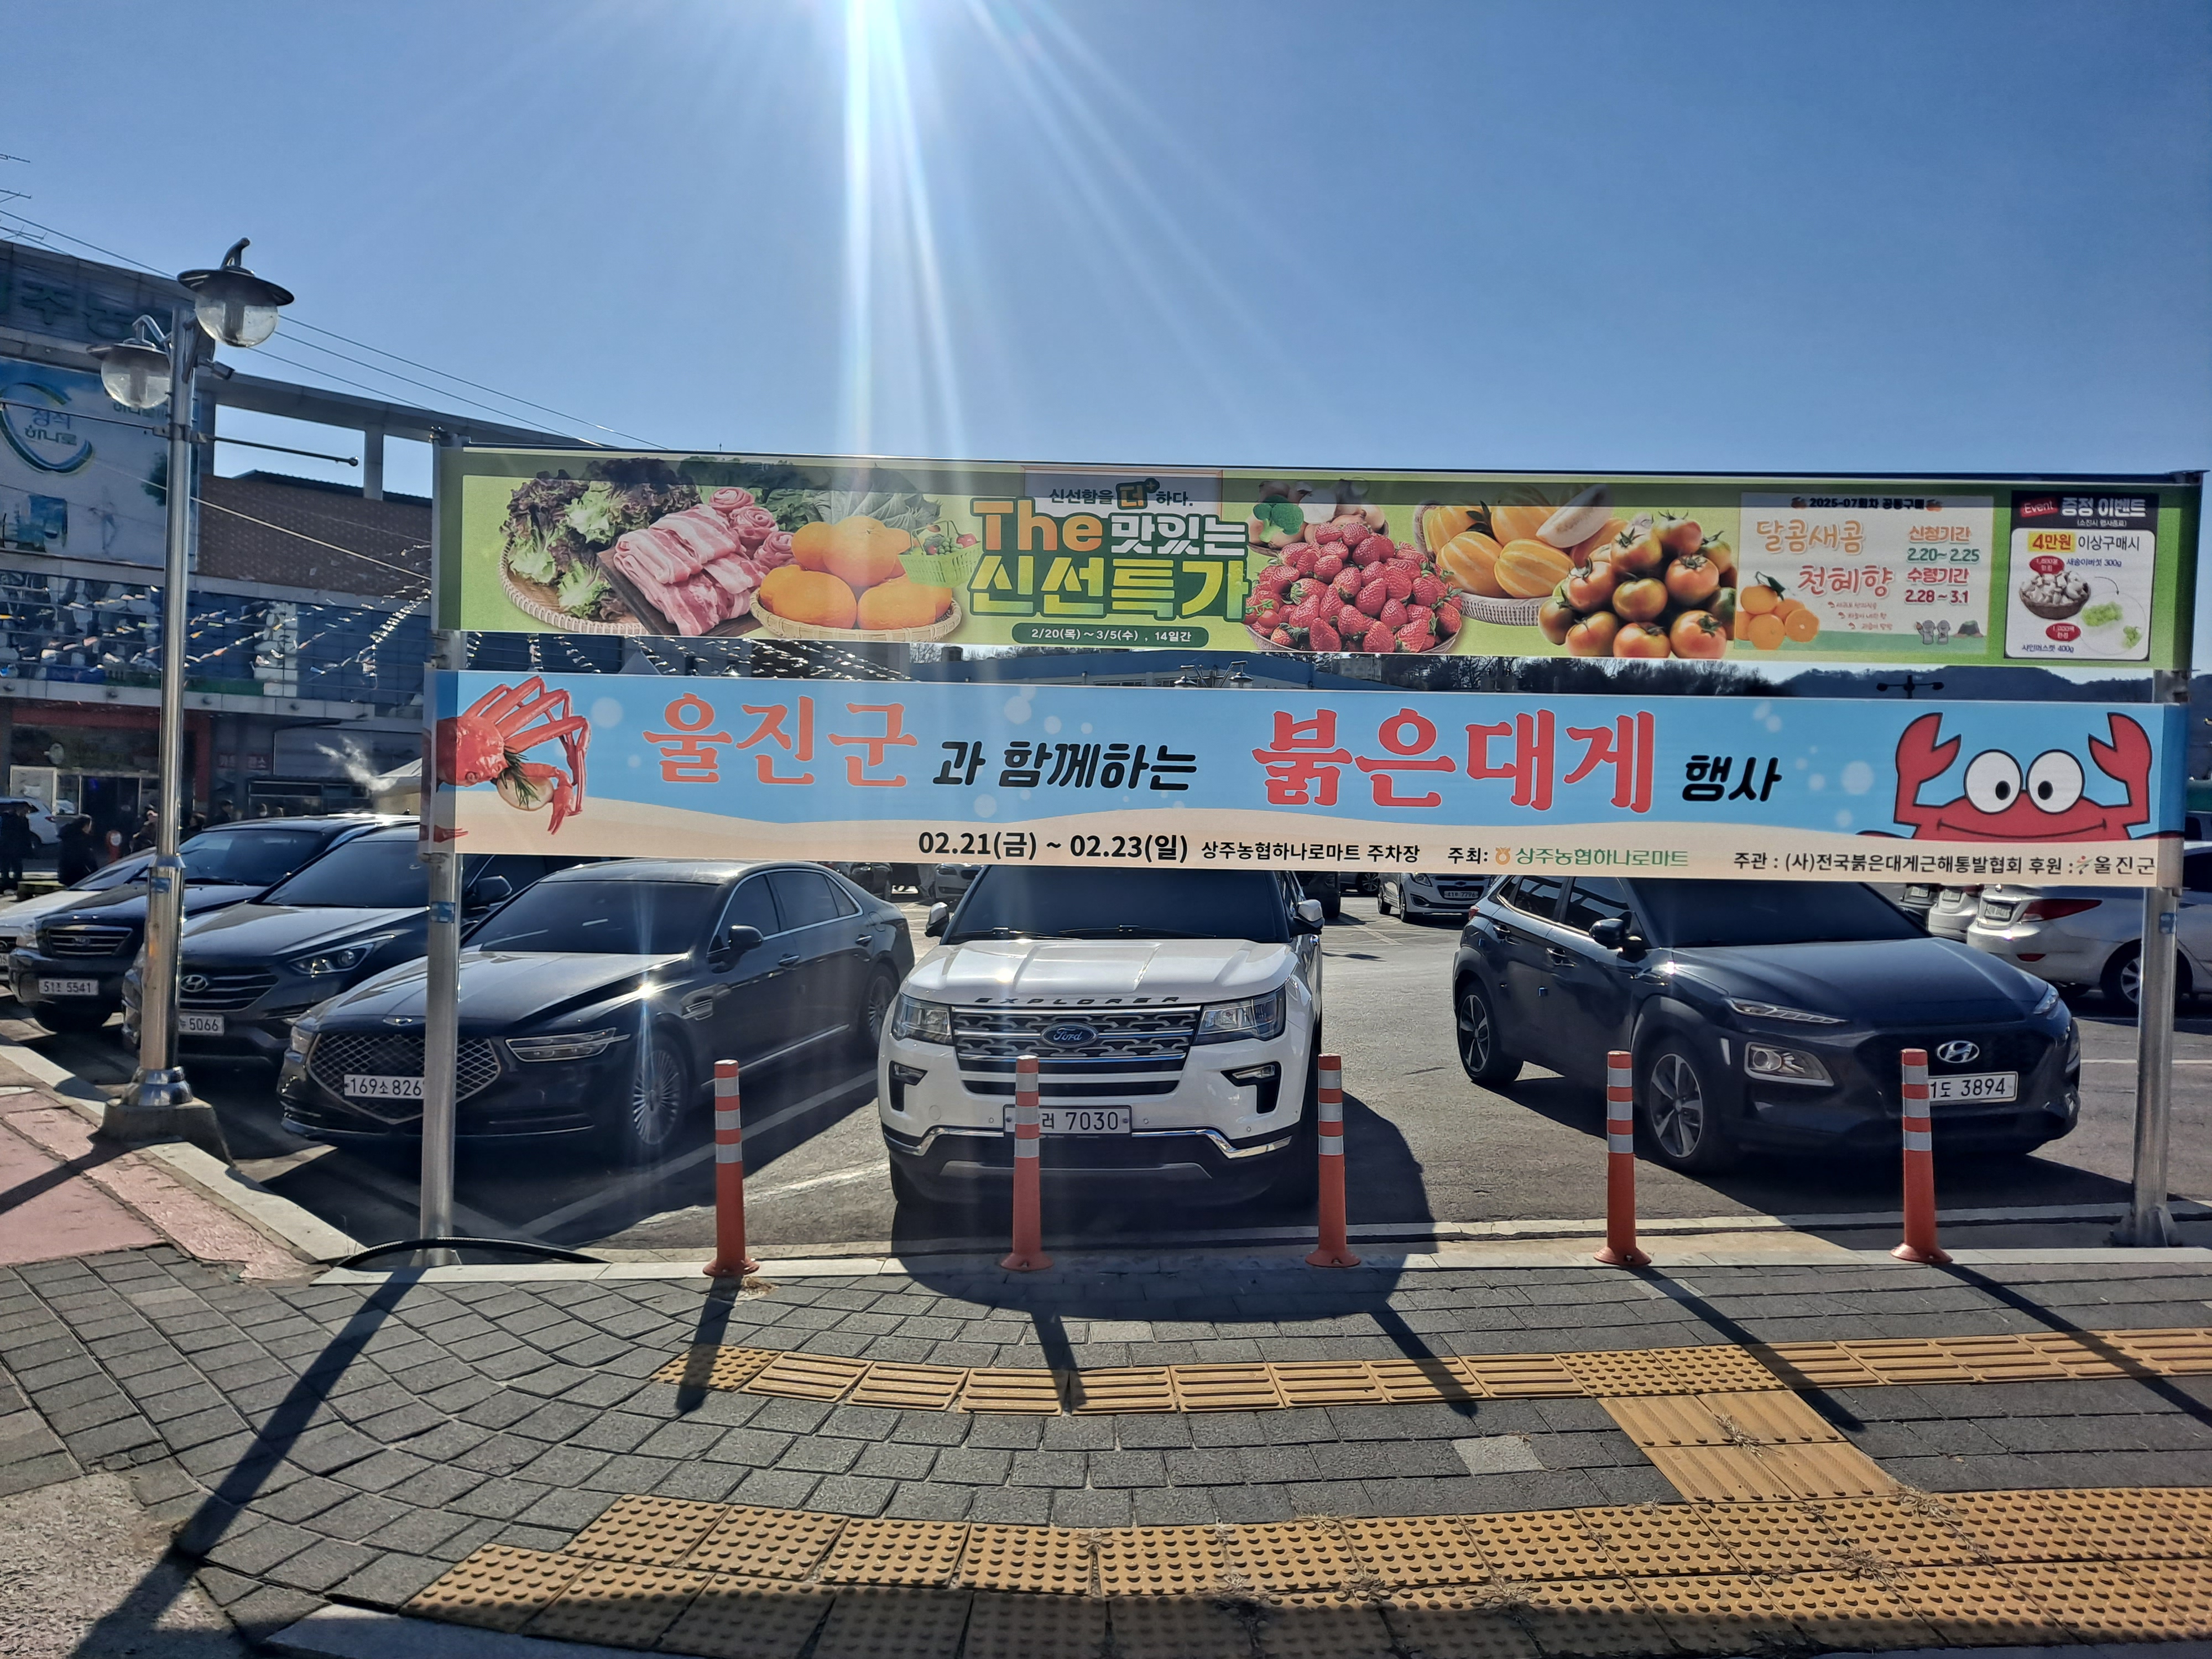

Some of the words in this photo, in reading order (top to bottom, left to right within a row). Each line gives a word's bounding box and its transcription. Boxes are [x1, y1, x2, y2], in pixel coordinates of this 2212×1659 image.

[24, 425, 77, 446] 하나로
[1050, 487, 1113, 505] 신선함을
[1155, 492, 1193, 507] 하다.
[2023, 500, 2053, 514] Event
[2061, 497, 2094, 517] 증정
[2098, 498, 2146, 518] 이벤트
[972, 499, 1103, 551] The
[1110, 515, 1246, 556] 맛있는
[1756, 519, 1865, 554] 달콤새콤
[2032, 534, 2072, 551] 4만원
[2078, 536, 2140, 551] 이상구매시
[1949, 548, 1980, 562] 2.25
[1798, 565, 1893, 597] 천혜향
[1906, 567, 1970, 584] 수령기간
[971, 555, 1249, 620] 신선특가
[1905, 589, 1935, 604] 2.28
[1950, 589, 1969, 604] 3.1
[1154, 630, 1192, 643] 14일간
[643, 693, 918, 787] 울진군
[933, 740, 986, 786] 과
[998, 740, 1197, 791] 함께하는
[1251, 708, 1656, 813] 붉은대게
[1681, 754, 1782, 802] 행사
[918, 832, 1037, 858] 02.21(금)
[1069, 834, 1188, 864] 02.23(일)
[1201, 841, 1360, 863] 상주농협하나로마트
[1366, 842, 1420, 864] 주차장
[1447, 846, 1489, 864] 주최:
[1515, 847, 1689, 868] 상주농협하나로마트
[1785, 852, 2023, 875] (사)전국붉은대게근해통발협회
[2094, 855, 2156, 875] 울진군
[66, 981, 91, 994] 5541
[975, 997, 1180, 1005] EXPLORER
[190, 1015, 218, 1031] 5066
[1053, 1028, 1083, 1041] Ford
[349, 1078, 388, 1094] 169소
[392, 1080, 425, 1097] 826
[1960, 1078, 2006, 1097] 3894
[1065, 1112, 1119, 1130] 7030
